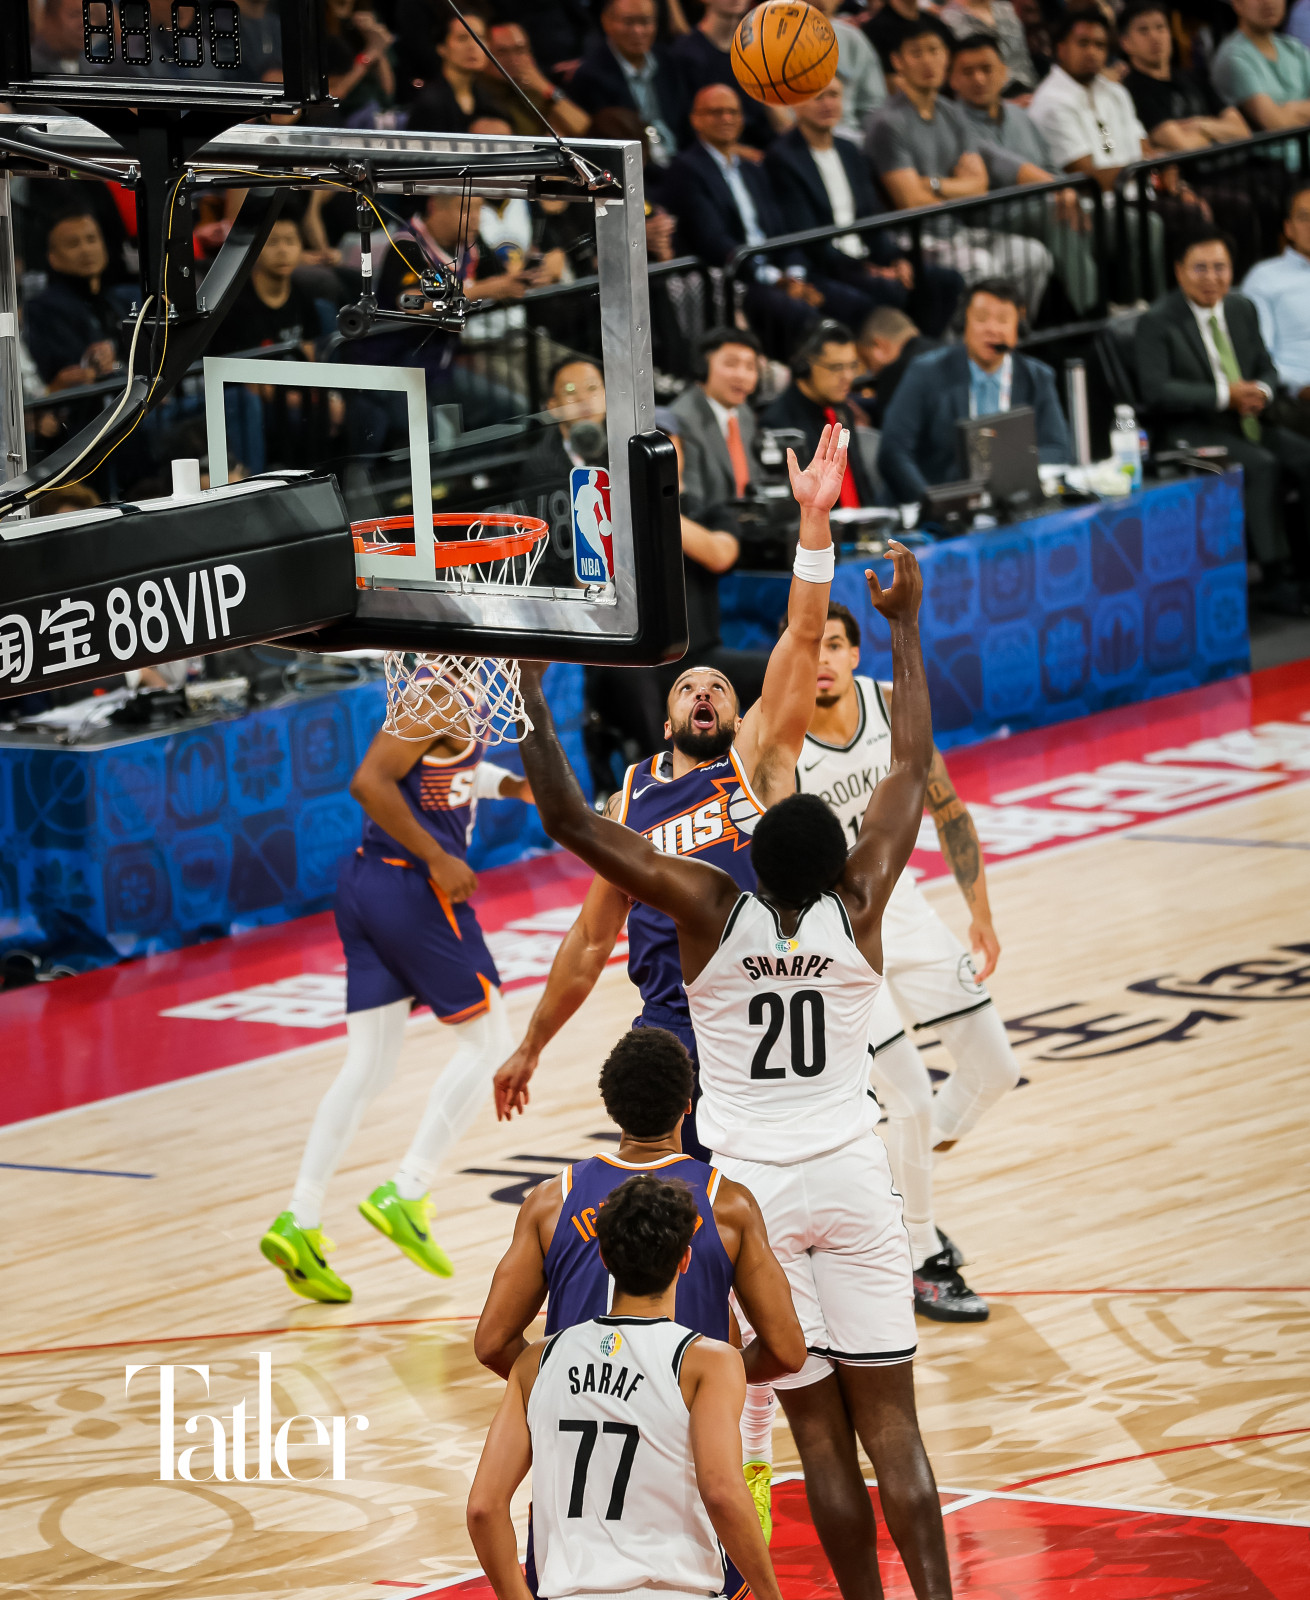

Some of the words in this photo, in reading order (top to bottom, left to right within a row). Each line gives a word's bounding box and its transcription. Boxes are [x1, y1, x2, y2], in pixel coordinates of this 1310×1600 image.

[580, 557, 601, 577] NBA
[742, 954, 834, 980] SHARPE
[748, 989, 826, 1080] 20
[568, 1362, 645, 1402] SARAF
[558, 1419, 641, 1521] 77
